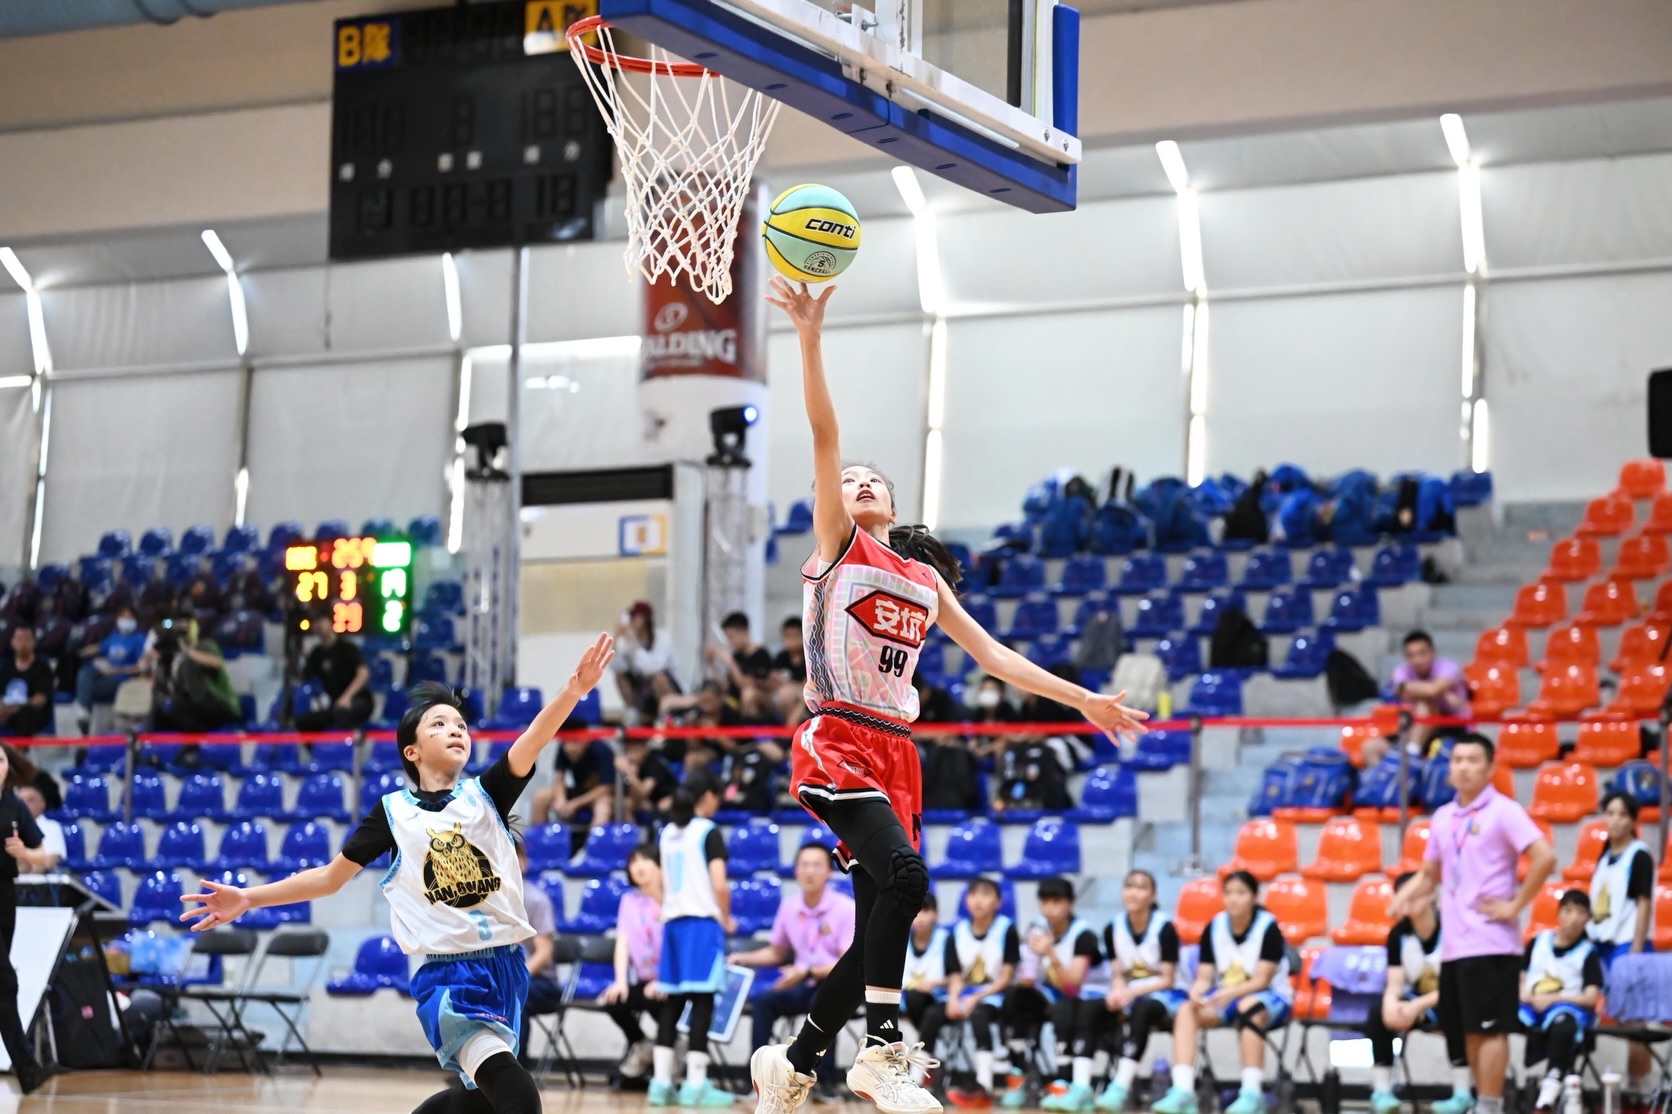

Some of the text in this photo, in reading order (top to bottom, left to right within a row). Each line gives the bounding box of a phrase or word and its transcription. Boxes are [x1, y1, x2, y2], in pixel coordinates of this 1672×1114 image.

[640, 329, 737, 364] ALDING
[873, 599, 926, 642] 安坑
[878, 645, 908, 677] 99
